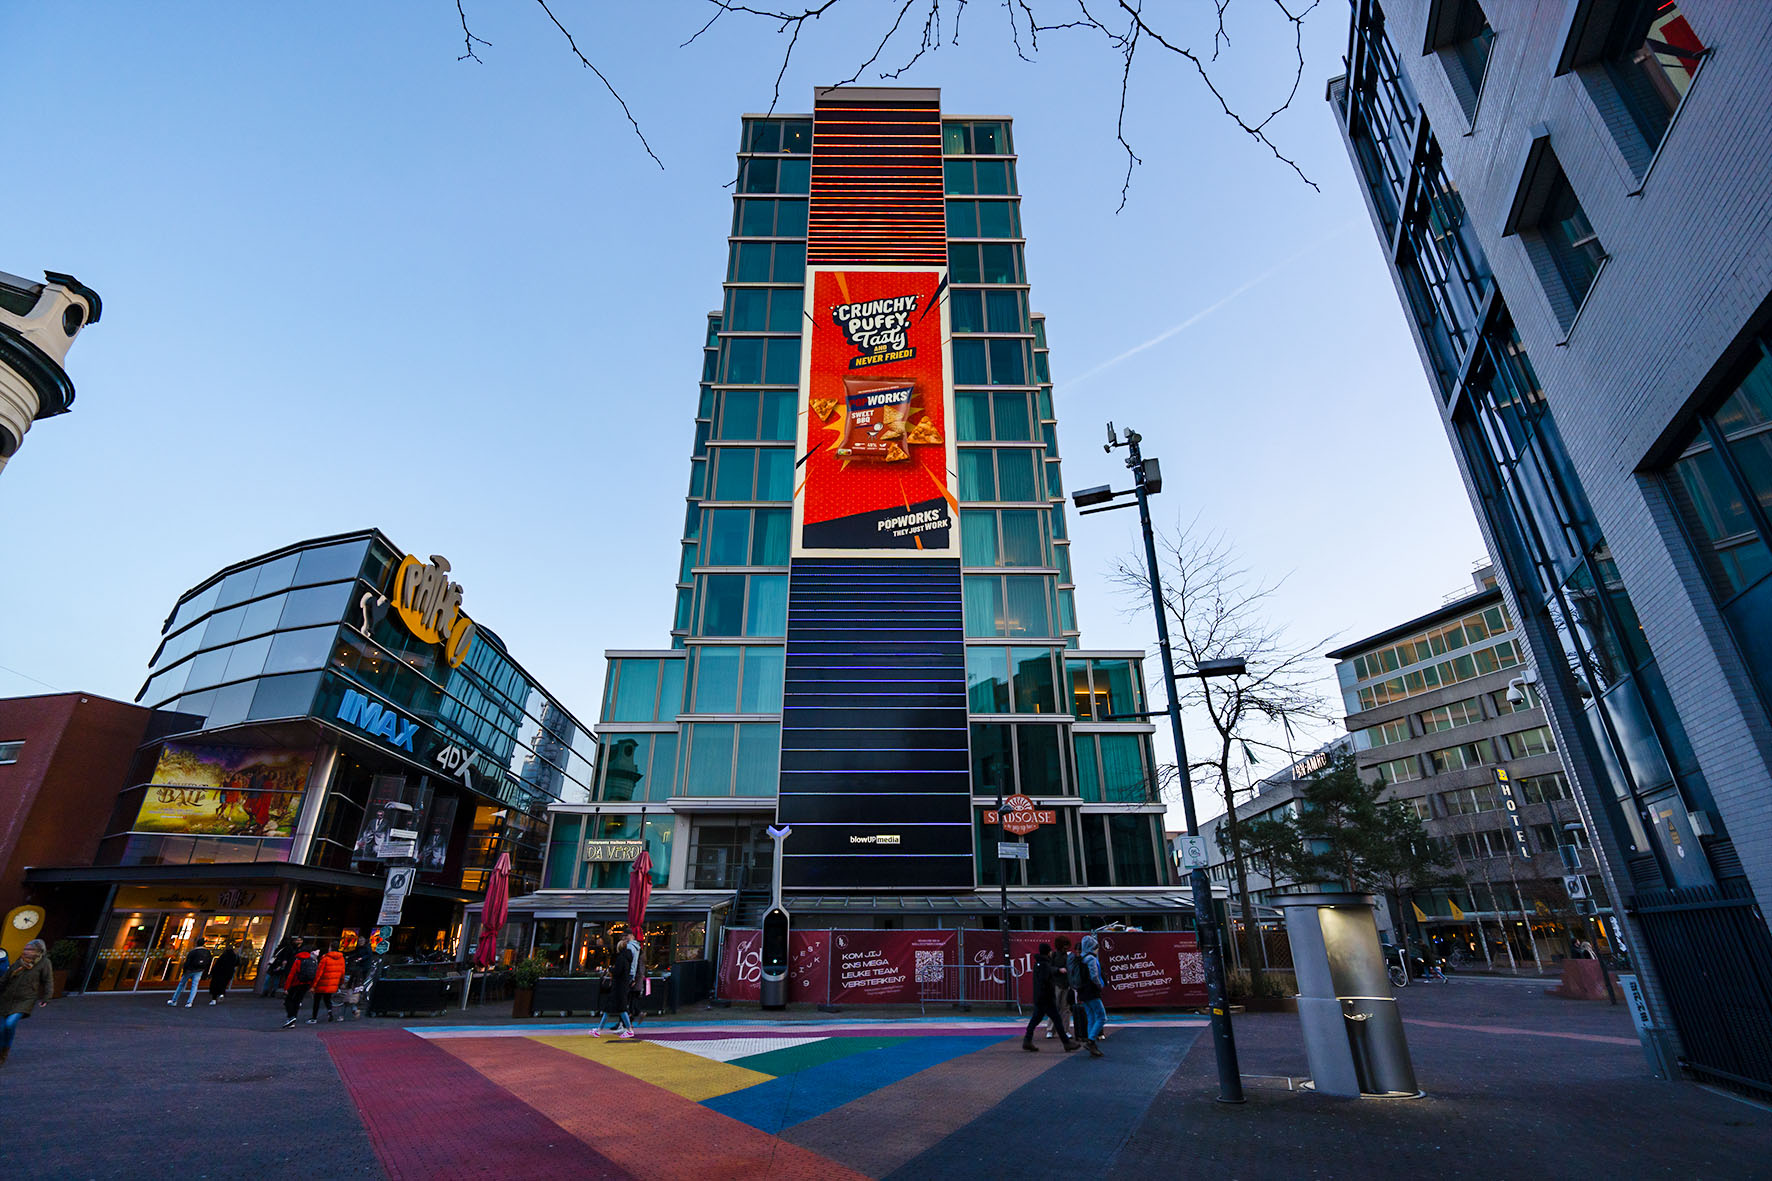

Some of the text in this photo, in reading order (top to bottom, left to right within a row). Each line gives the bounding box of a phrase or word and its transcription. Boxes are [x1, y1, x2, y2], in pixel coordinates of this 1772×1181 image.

[838, 296, 916, 321] CRUNCHY,
[848, 312, 910, 334] PUFFY,
[852, 325, 905, 350] Tasty
[873, 344, 887, 352] AND
[856, 349, 913, 366] NEVER FRIED!
[849, 390, 908, 407] POPWORKS
[851, 410, 874, 419] SWEET
[856, 416, 870, 424] BBQ
[877, 509, 940, 531] POPWORKS
[892, 519, 948, 537] THEY JUST WORK
[336, 688, 420, 753] IMAX
[436, 744, 480, 789] 4DX
[1500, 784, 1531, 858] HOTEL
[587, 845, 603, 859] DA
[793, 942, 820, 961] VEST
[842, 952, 863, 960] KOM
[1109, 955, 1129, 963] KOM
[791, 957, 820, 978] DIJK
[842, 959, 889, 969] ONS MEGA
[1110, 961, 1155, 972] ONS MEGA
[842, 967, 898, 979] LEUKE TEAM
[1110, 969, 1164, 981] LEUKE TEAM
[842, 975, 906, 988] VERSTERKEN?
[1112, 977, 1172, 991] VERSTERKEN?
